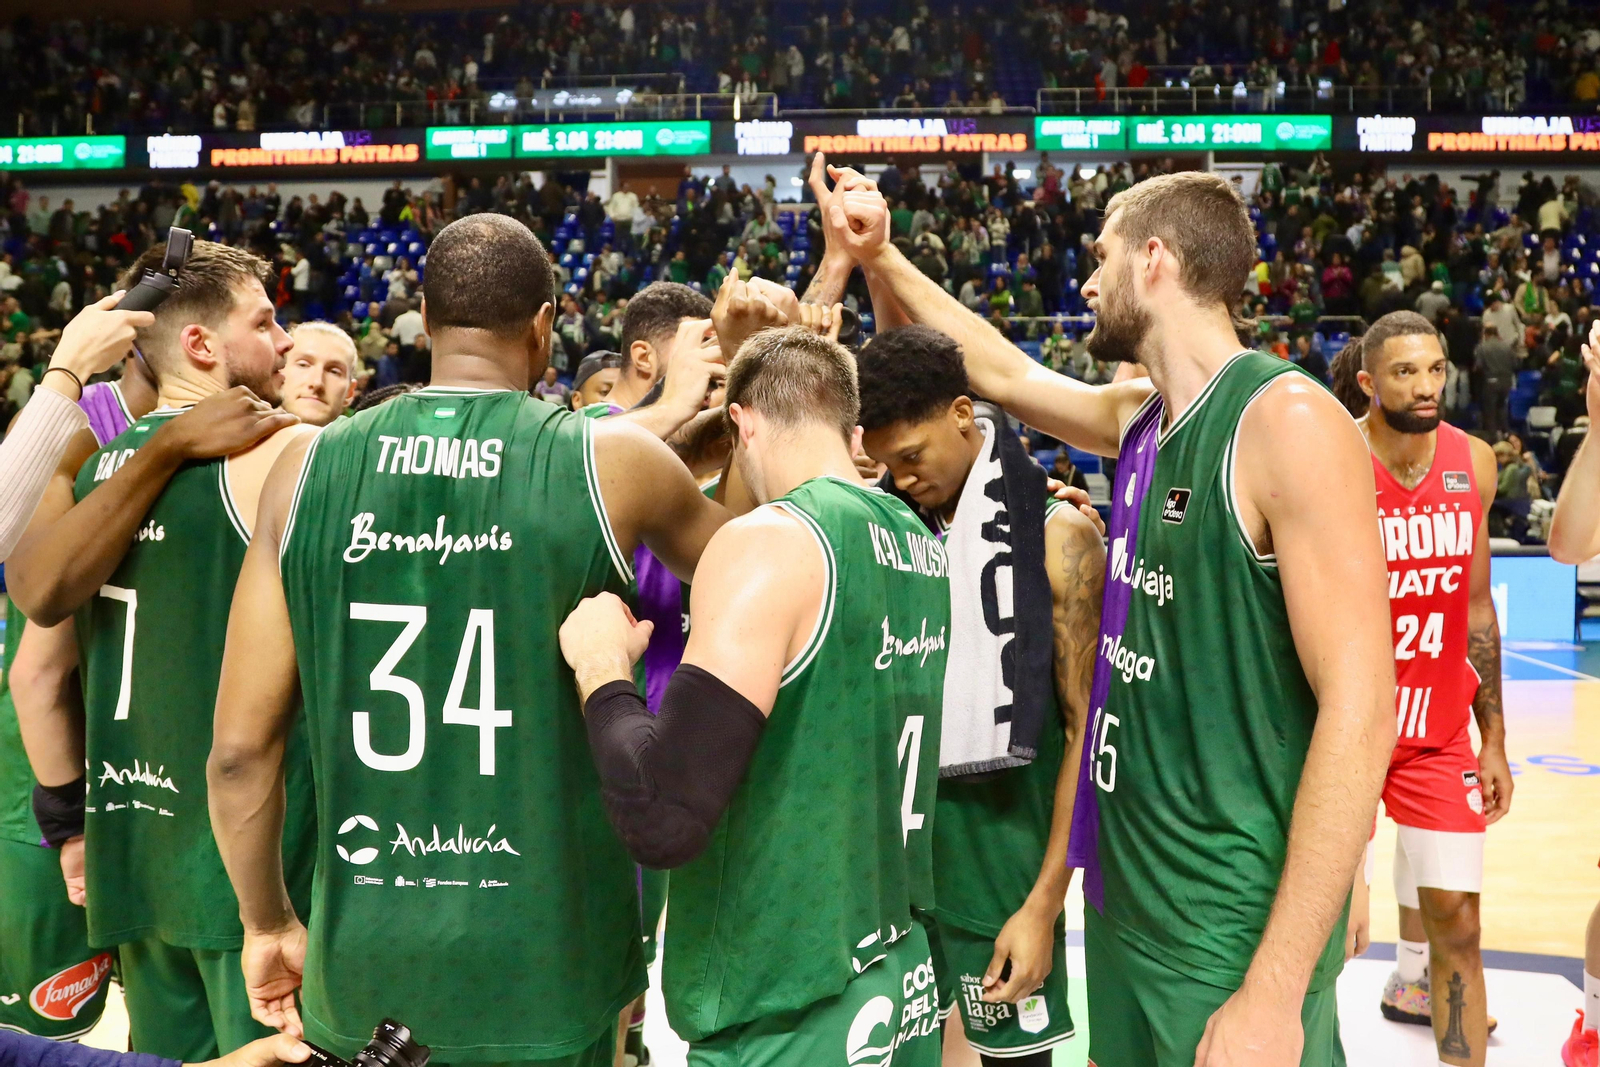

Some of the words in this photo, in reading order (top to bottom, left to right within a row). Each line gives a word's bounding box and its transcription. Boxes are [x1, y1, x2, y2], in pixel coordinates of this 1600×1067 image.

[857, 118, 948, 137] UNICAJA
[1171, 123, 1206, 144] 3.04
[1482, 116, 1574, 136] UNICAJA
[804, 134, 940, 153] PROMITHEAS
[943, 133, 1027, 152] PATRAS
[1427, 132, 1567, 151] PROMITHEAS
[340, 144, 419, 164] PATRAS
[376, 435, 503, 478] THOMAS
[1388, 565, 1463, 599] IATC
[1395, 612, 1444, 660] 24
[349, 602, 513, 776] 34
[389, 822, 522, 858] Andalucía
[960, 973, 981, 984] sabor
[901, 993, 932, 1028] DEL
